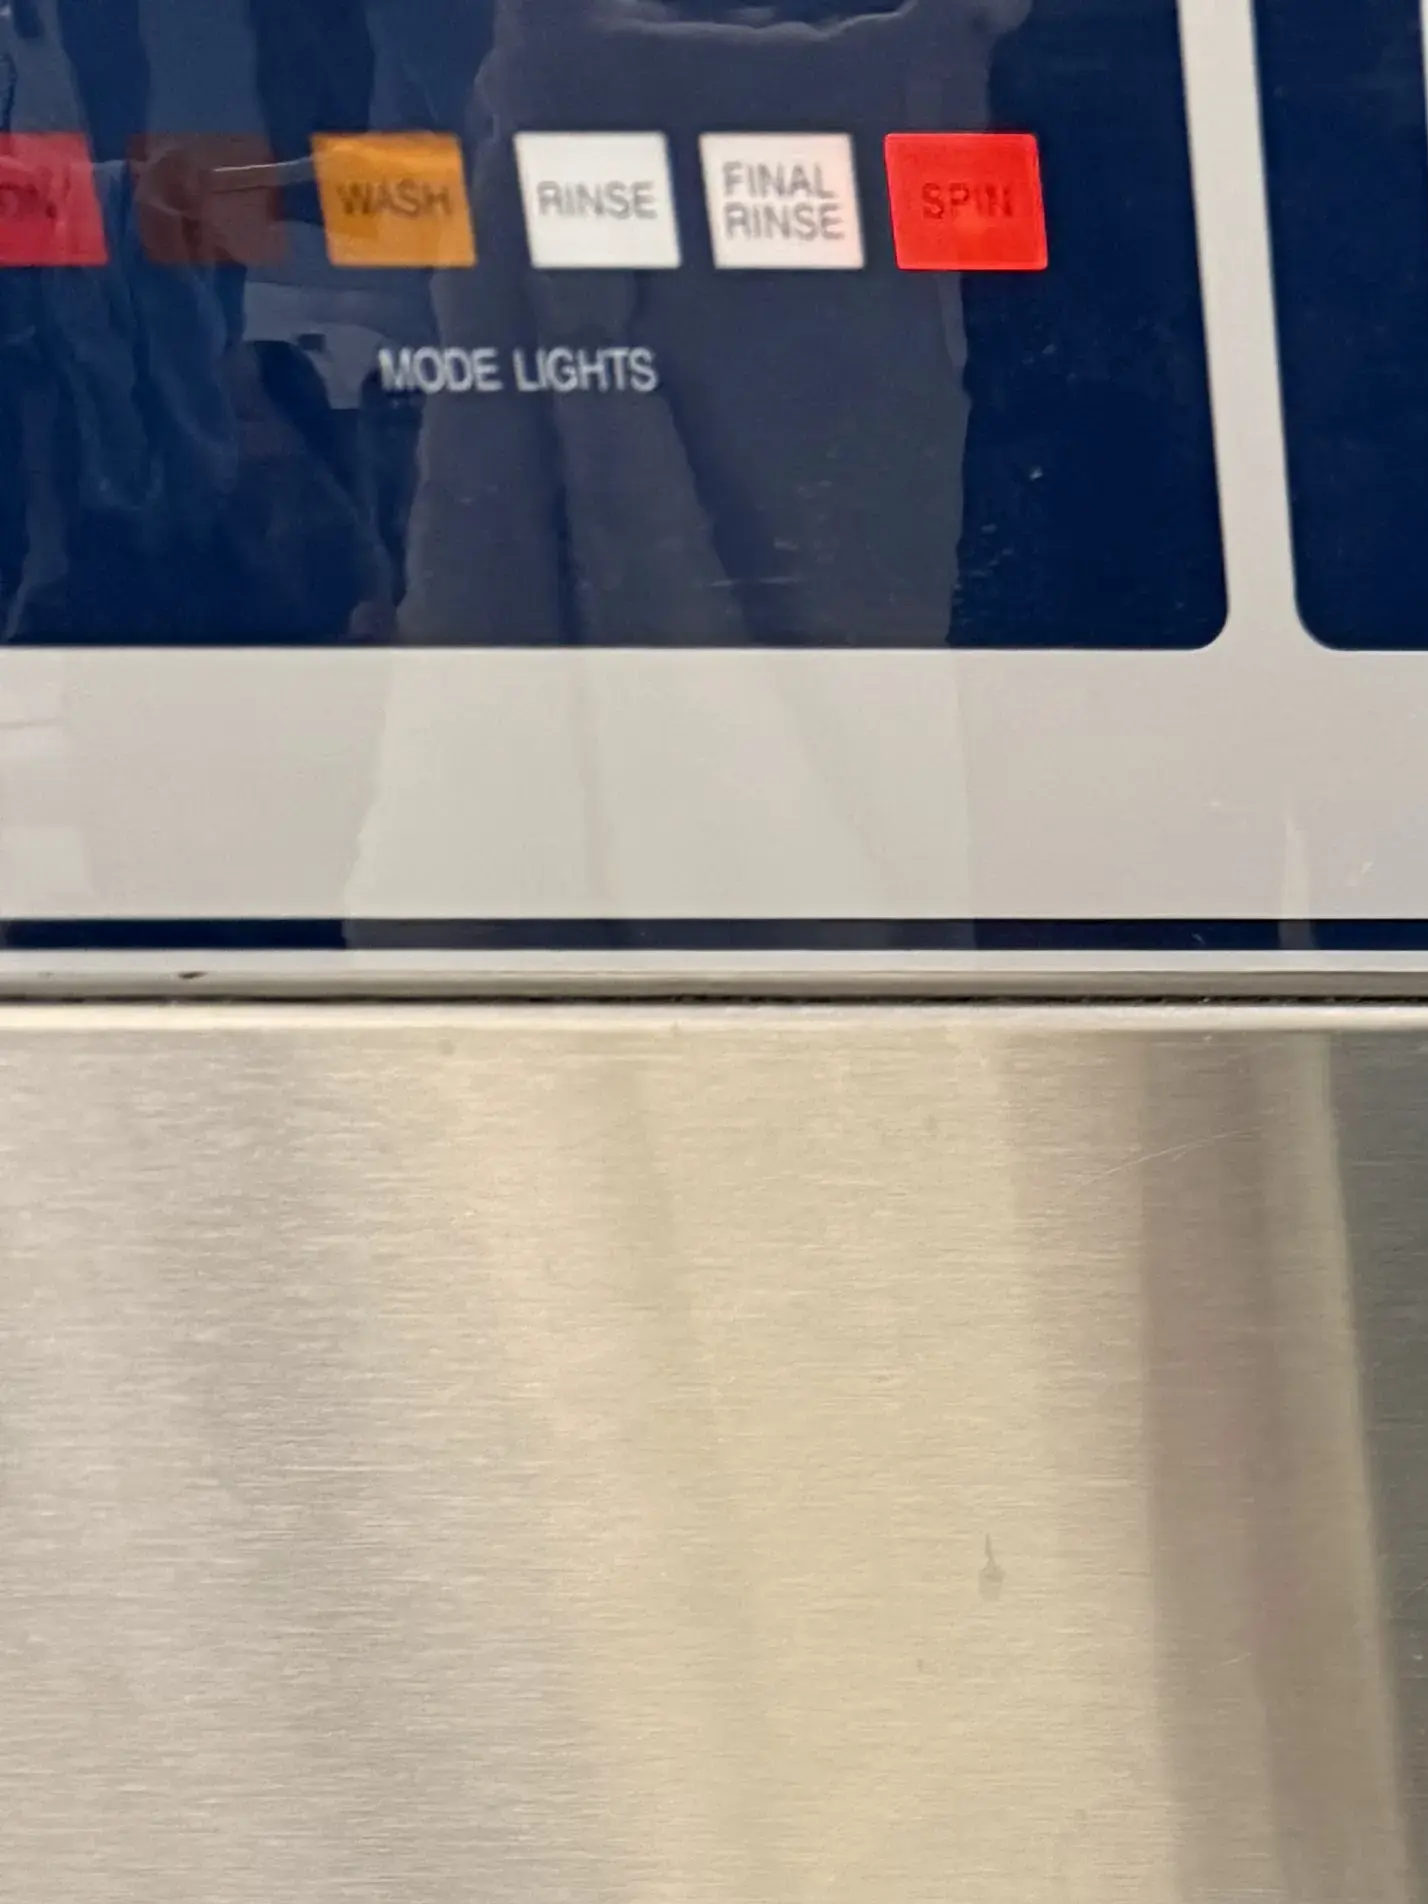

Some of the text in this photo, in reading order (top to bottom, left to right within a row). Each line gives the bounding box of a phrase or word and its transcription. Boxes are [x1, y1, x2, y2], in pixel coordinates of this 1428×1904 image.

[336, 177, 452, 217] WASH
[722, 161, 835, 198] FINAL
[536, 180, 657, 219] RINSE
[921, 182, 1014, 219] SPIN
[724, 203, 845, 240] RINSE
[378, 347, 657, 392] MODE LIGHTS
